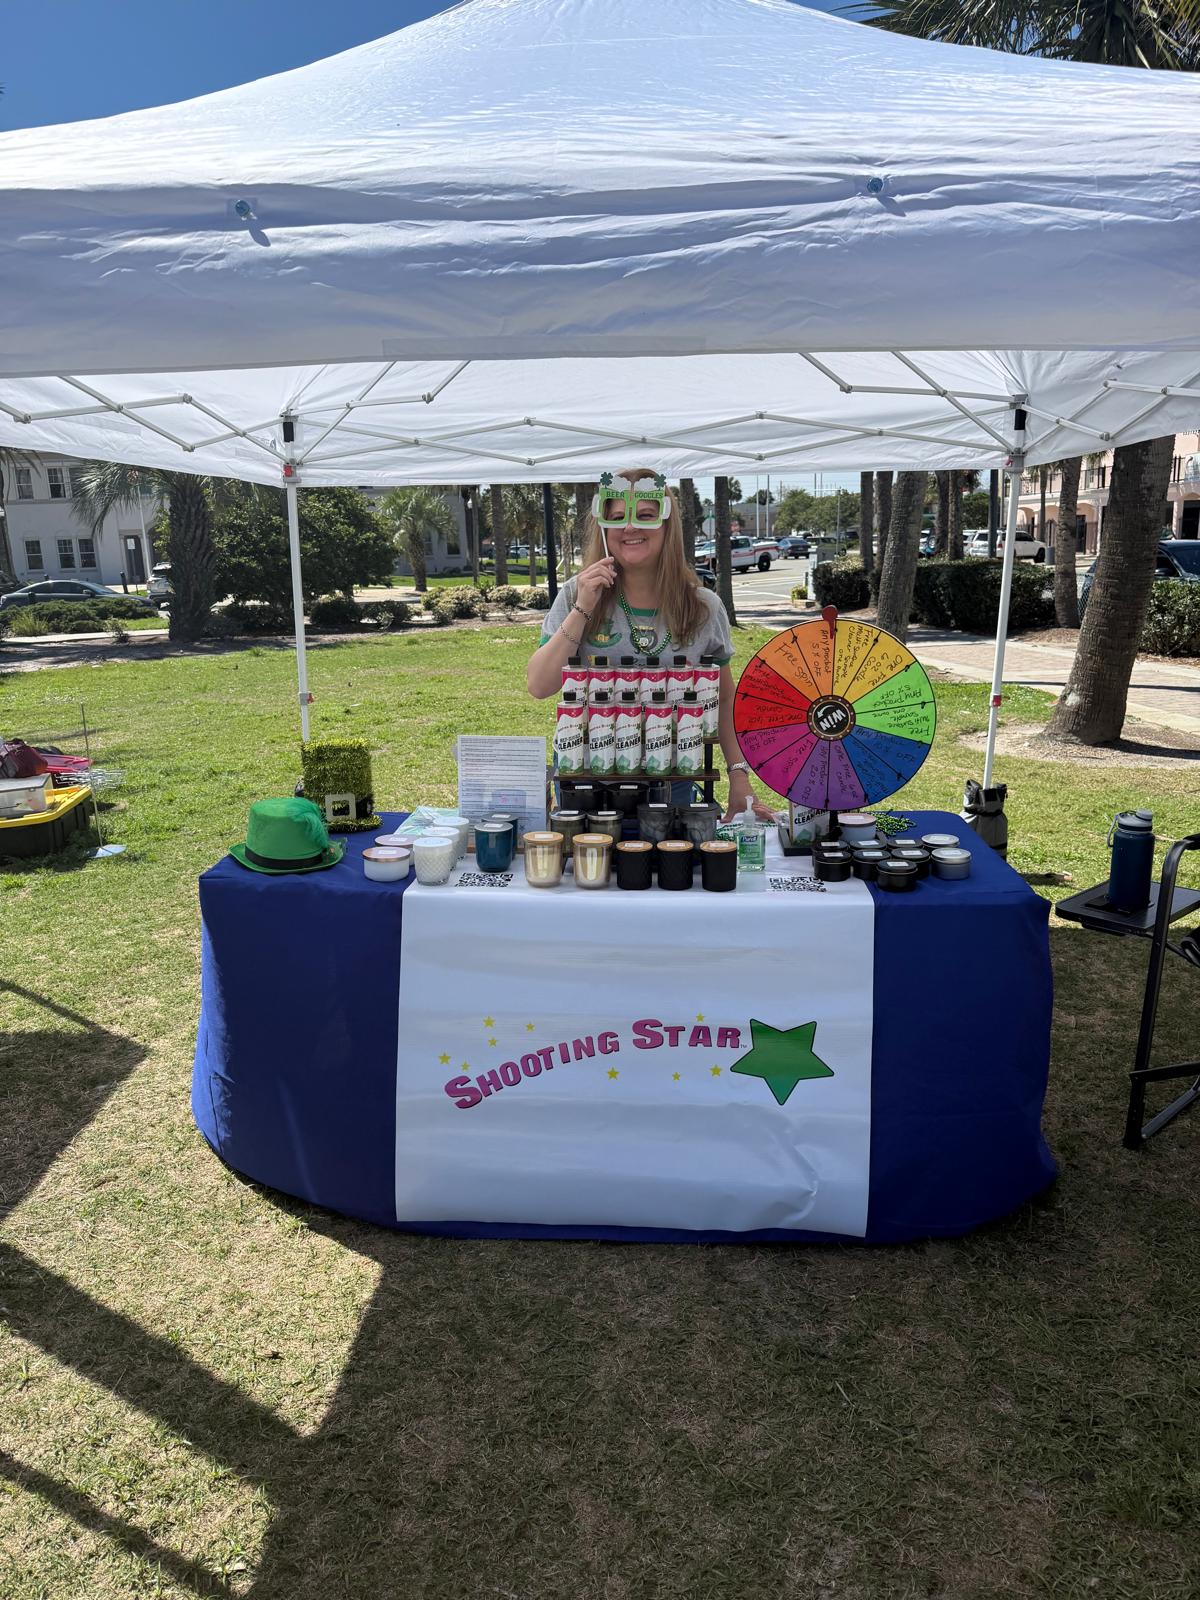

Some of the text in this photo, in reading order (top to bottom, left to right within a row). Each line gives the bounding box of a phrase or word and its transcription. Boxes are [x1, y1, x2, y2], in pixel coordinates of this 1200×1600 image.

[774, 642, 797, 665] Free
[904, 688, 922, 699] Any
[558, 737, 582, 750] CLEANER
[590, 736, 614, 750] CLEANER
[616, 736, 640, 749] CLEANER
[646, 737, 670, 750] CLEANER
[444, 1032, 620, 1109] SHOOTING
[632, 1018, 740, 1049] STAR
